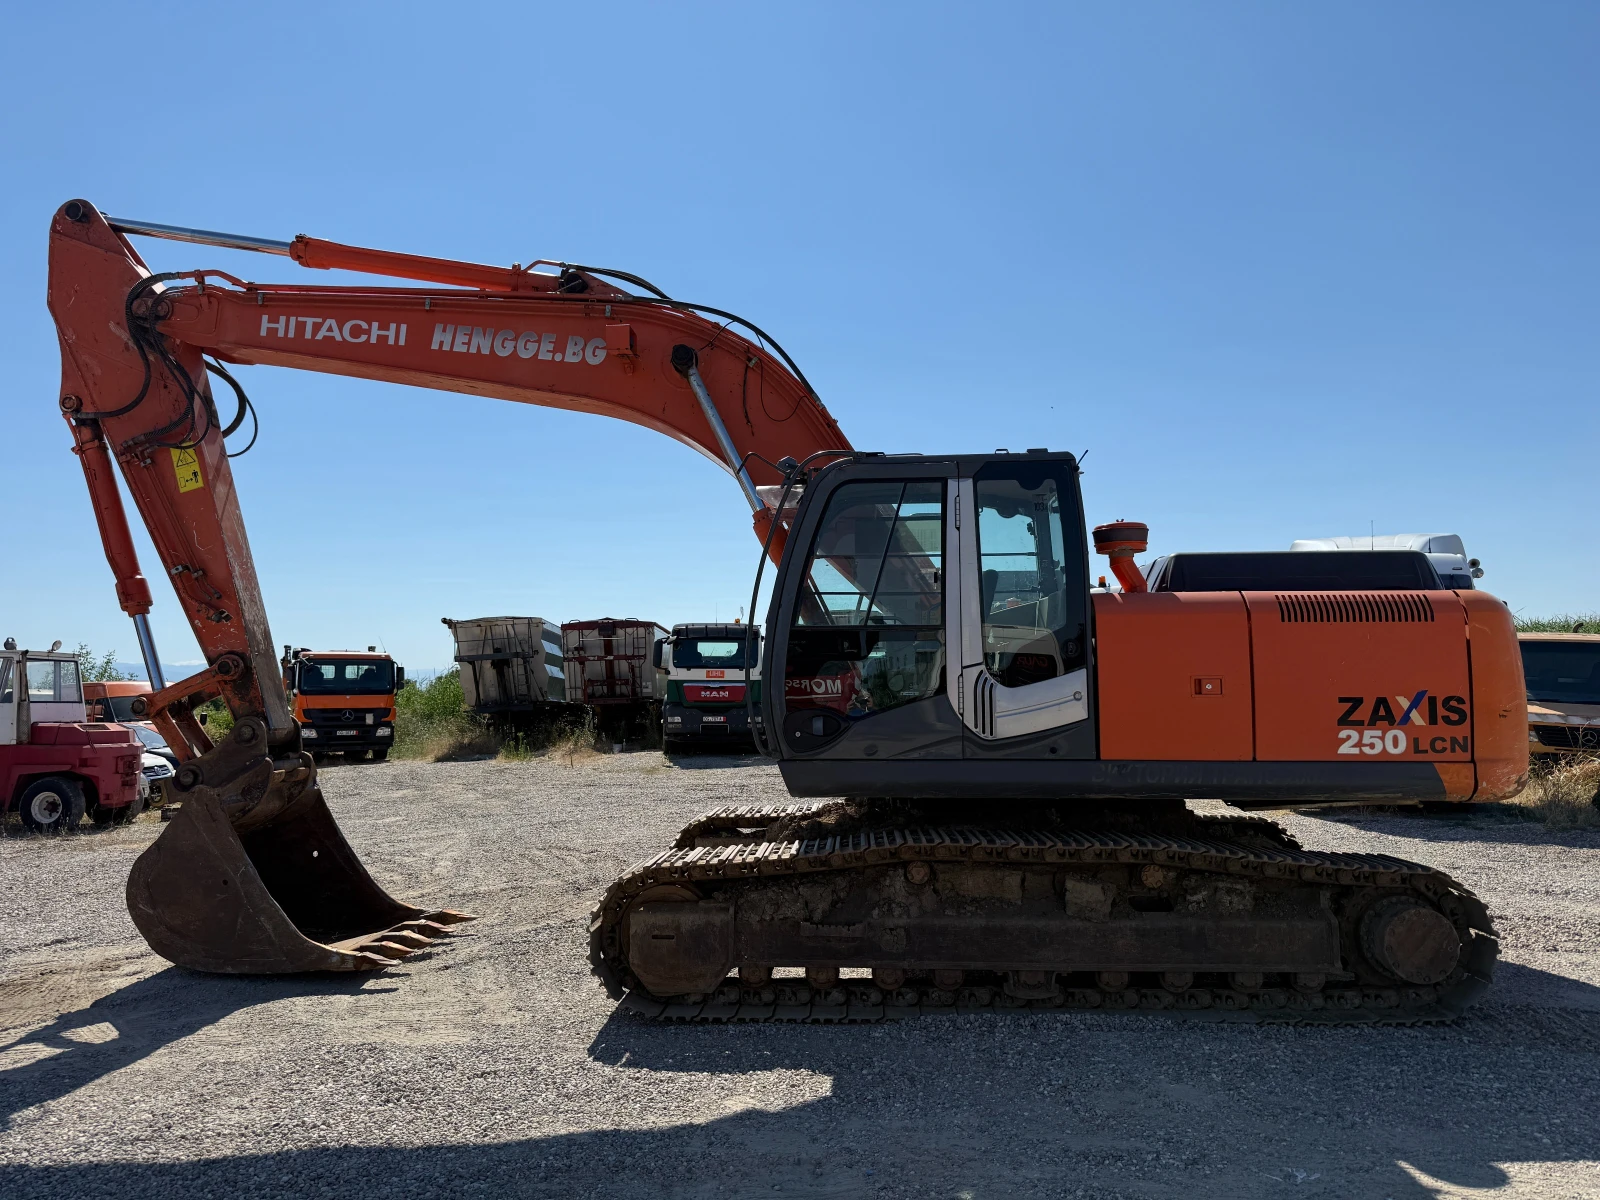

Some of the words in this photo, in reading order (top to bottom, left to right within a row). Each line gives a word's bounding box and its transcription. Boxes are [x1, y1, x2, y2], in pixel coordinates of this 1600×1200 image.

[259, 314, 407, 346] HITACHI
[430, 323, 607, 365] HENGGE.BG
[1337, 690, 1468, 726] ZAXIS
[1337, 729, 1407, 755] 250
[1413, 736, 1469, 754] LCN
